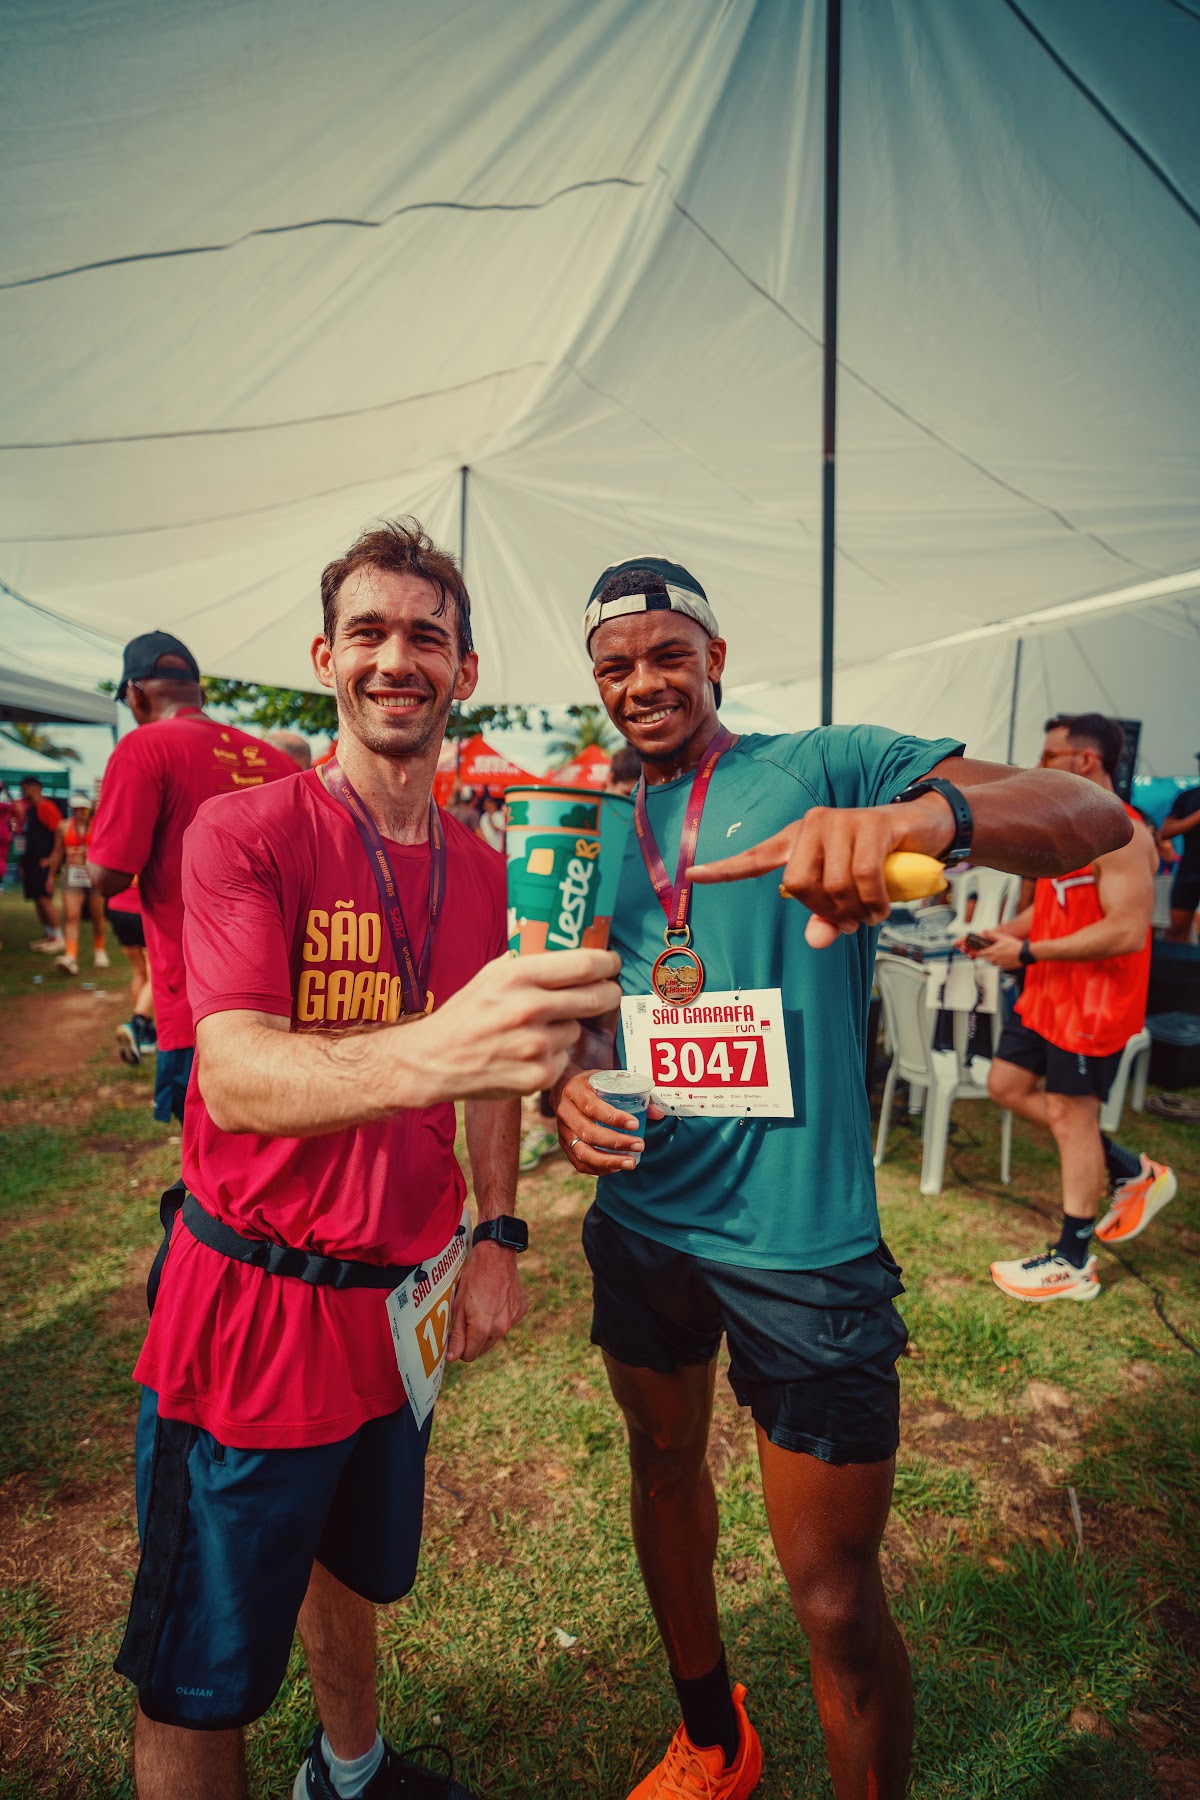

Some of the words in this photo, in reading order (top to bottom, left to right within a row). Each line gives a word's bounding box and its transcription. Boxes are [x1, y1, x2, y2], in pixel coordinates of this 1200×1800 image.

[375, 850, 392, 882] GARRAFA
[385, 882, 395, 898] SÃO
[676, 888, 689, 920] GARRAFA
[303, 899, 382, 963] SÃO
[389, 906, 407, 940] 2025
[652, 1004, 679, 1025] SÃO
[683, 1004, 755, 1024] GARRAFA
[735, 1024, 756, 1033] run
[655, 1041, 758, 1083] 3047
[431, 1235, 465, 1286] GARRAFA
[175, 1686, 214, 1698] OLAIAN
